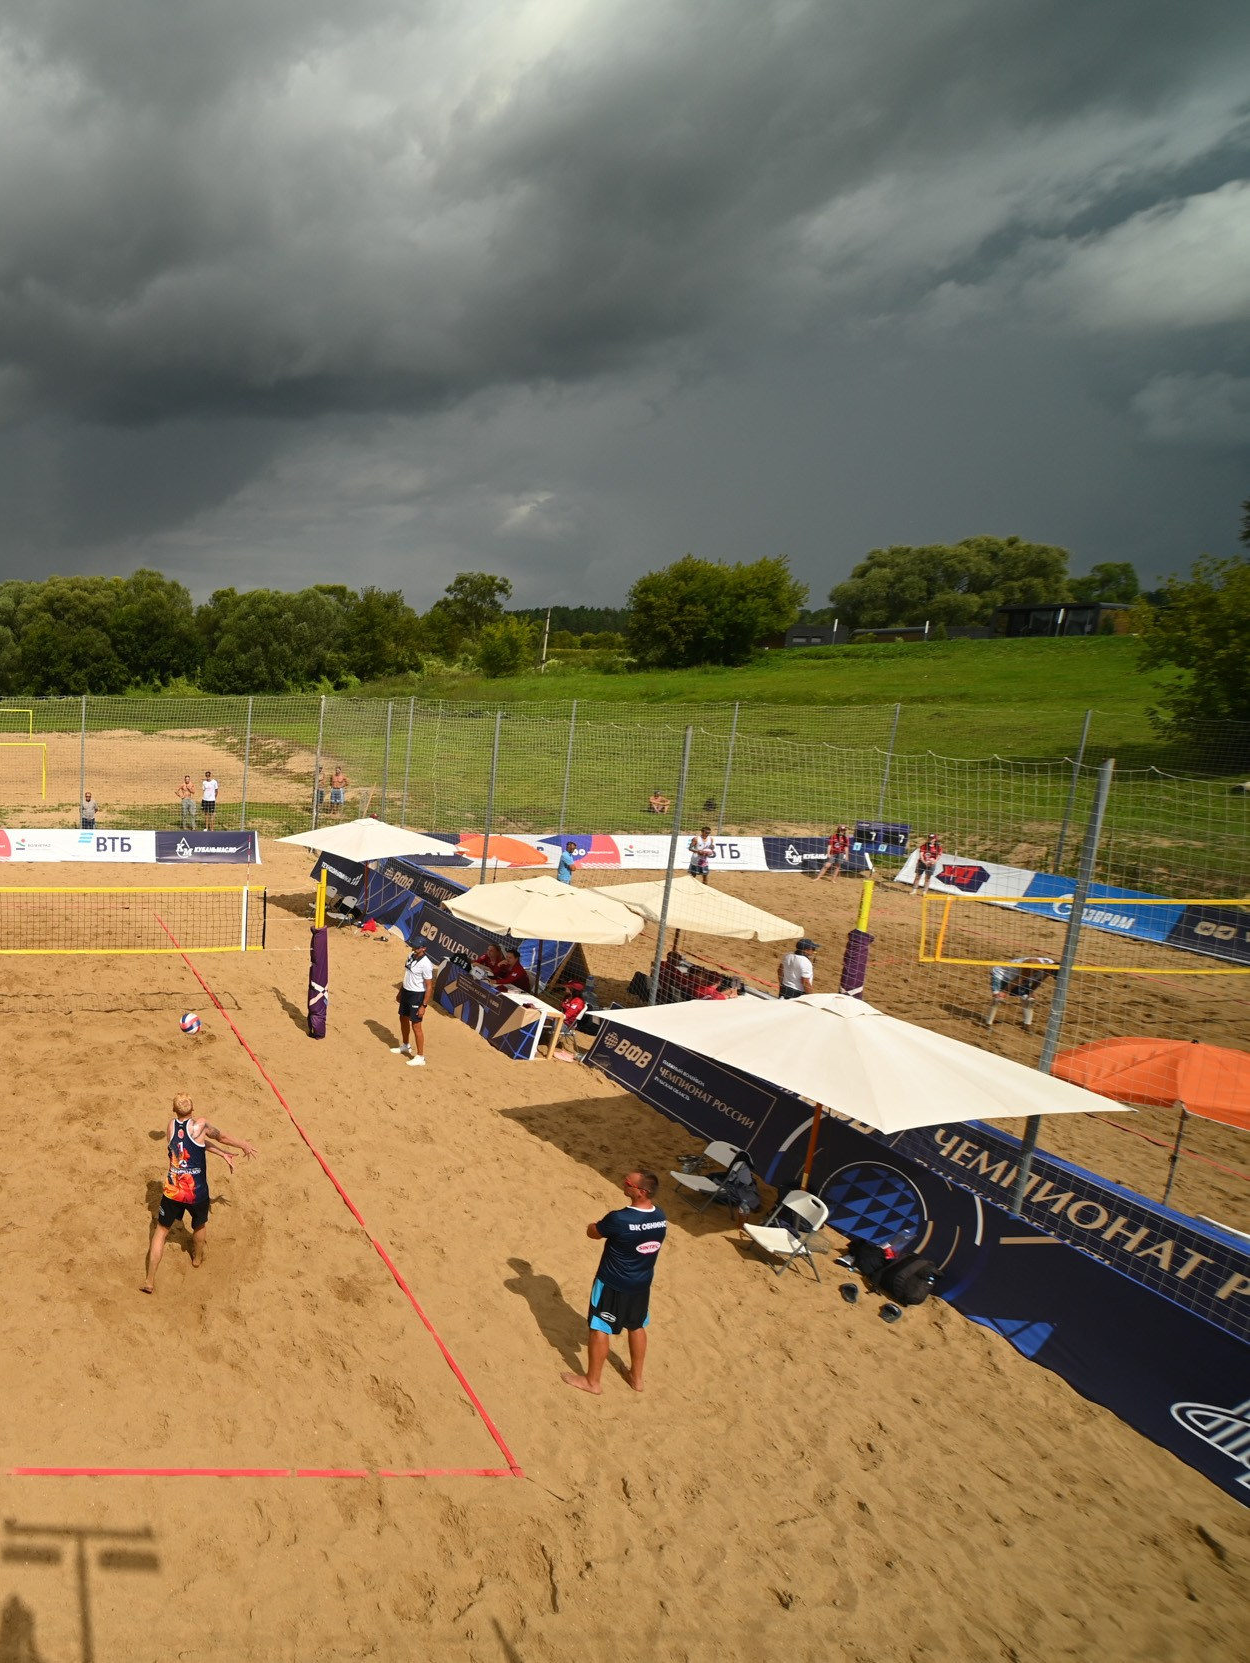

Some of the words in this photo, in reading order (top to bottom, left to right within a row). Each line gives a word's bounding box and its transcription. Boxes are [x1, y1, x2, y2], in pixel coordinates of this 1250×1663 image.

[96, 836, 132, 853] ВТБ
[869, 831, 877, 841] 7
[898, 834, 905, 844] 7
[614, 1038, 653, 1069] ВФВ
[659, 1066, 714, 1104] ЧЕМПИОНАТ
[712, 1098, 755, 1129] РОССИИ
[933, 1128, 1217, 1281] ЧЕМПИОНАТ
[628, 1223, 642, 1231] ВК
[638, 1243, 660, 1251] SINTEC
